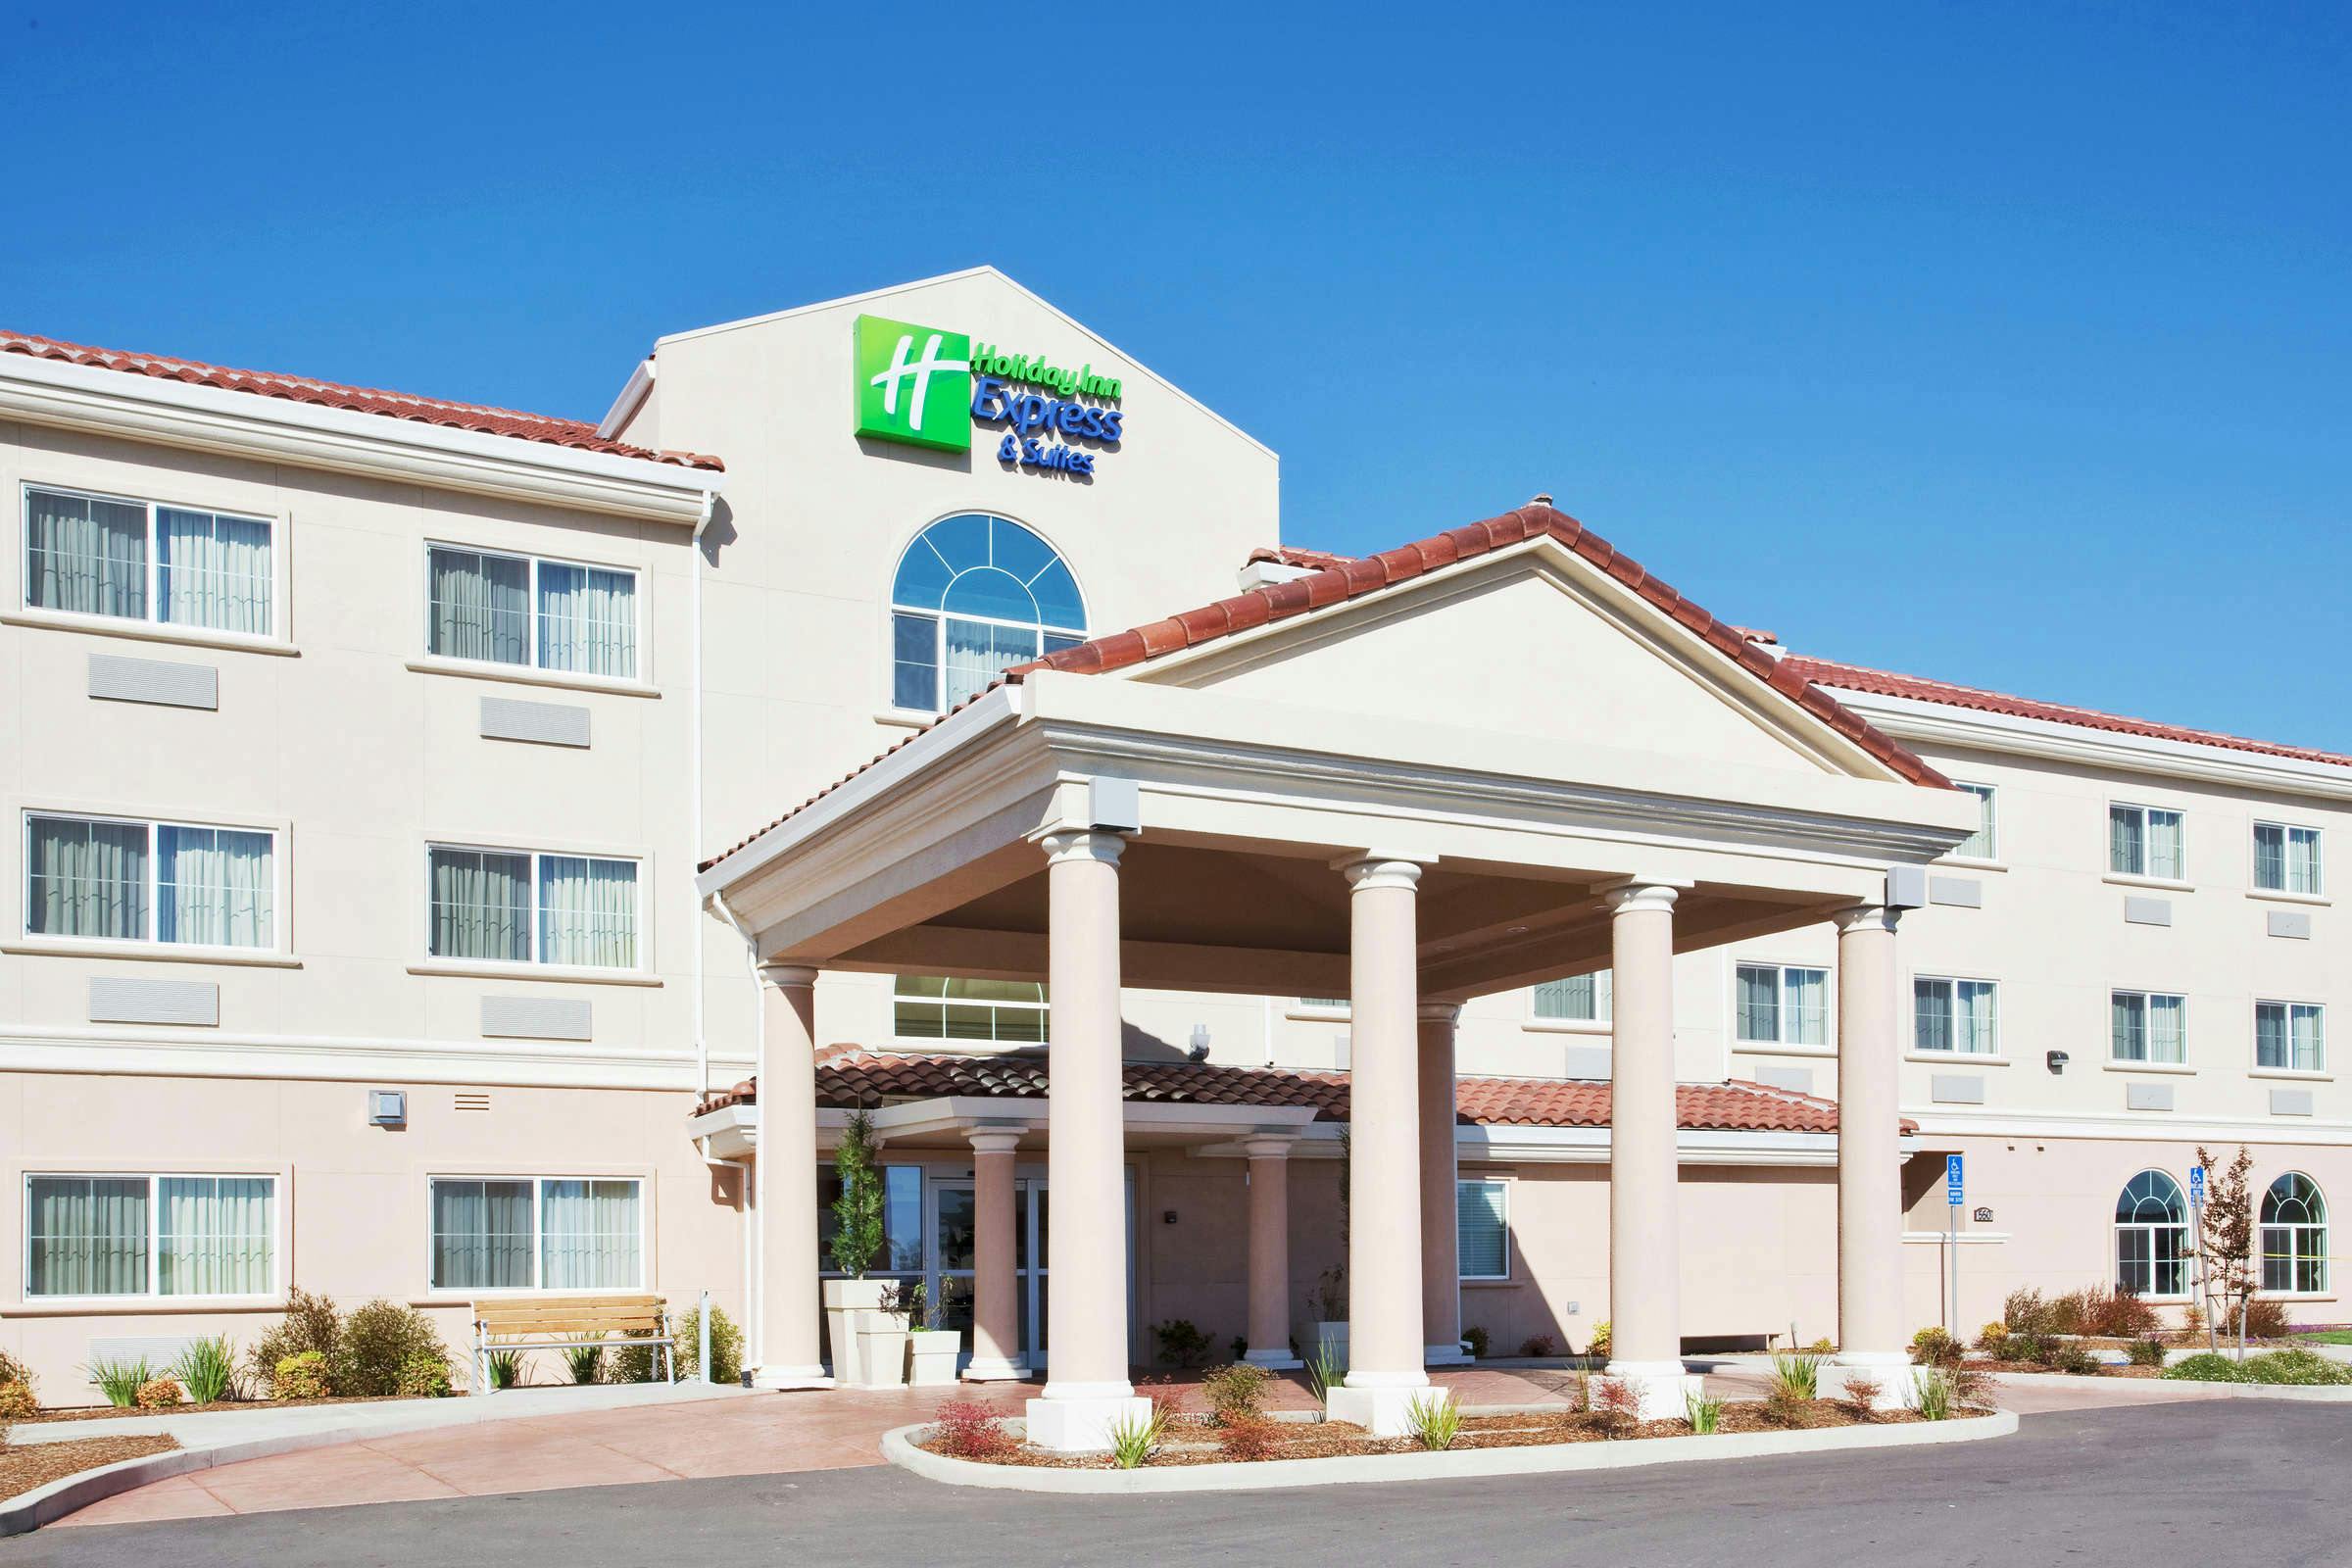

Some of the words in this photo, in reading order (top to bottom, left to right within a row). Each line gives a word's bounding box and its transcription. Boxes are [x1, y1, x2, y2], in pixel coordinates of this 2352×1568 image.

[870, 333, 970, 431] H
[971, 342, 1077, 395] Holiday
[1078, 364, 1121, 398] Inn
[972, 376, 1123, 441] Express
[998, 434, 1017, 463] &
[1022, 438, 1094, 475] Suites
